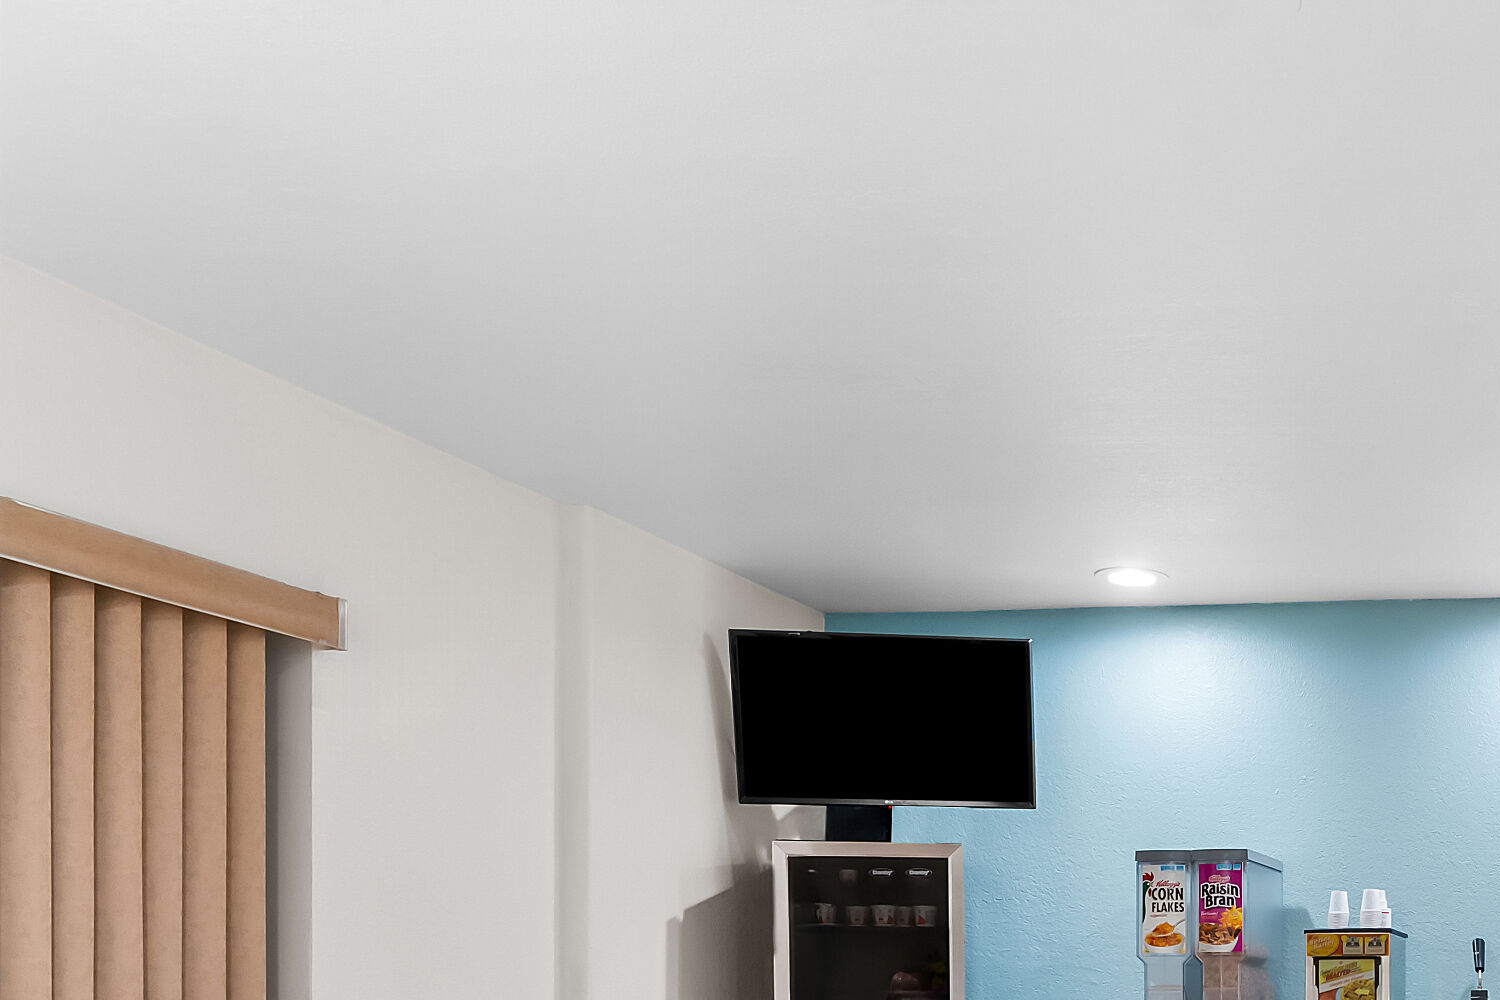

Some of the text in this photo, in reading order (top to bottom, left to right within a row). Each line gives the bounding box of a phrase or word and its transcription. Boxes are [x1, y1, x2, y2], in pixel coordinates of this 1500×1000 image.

[1152, 887, 1184, 901] CORN
[1202, 883, 1239, 898] Raisin
[1152, 902, 1185, 913] FLAKES
[1206, 895, 1235, 908] Bran
